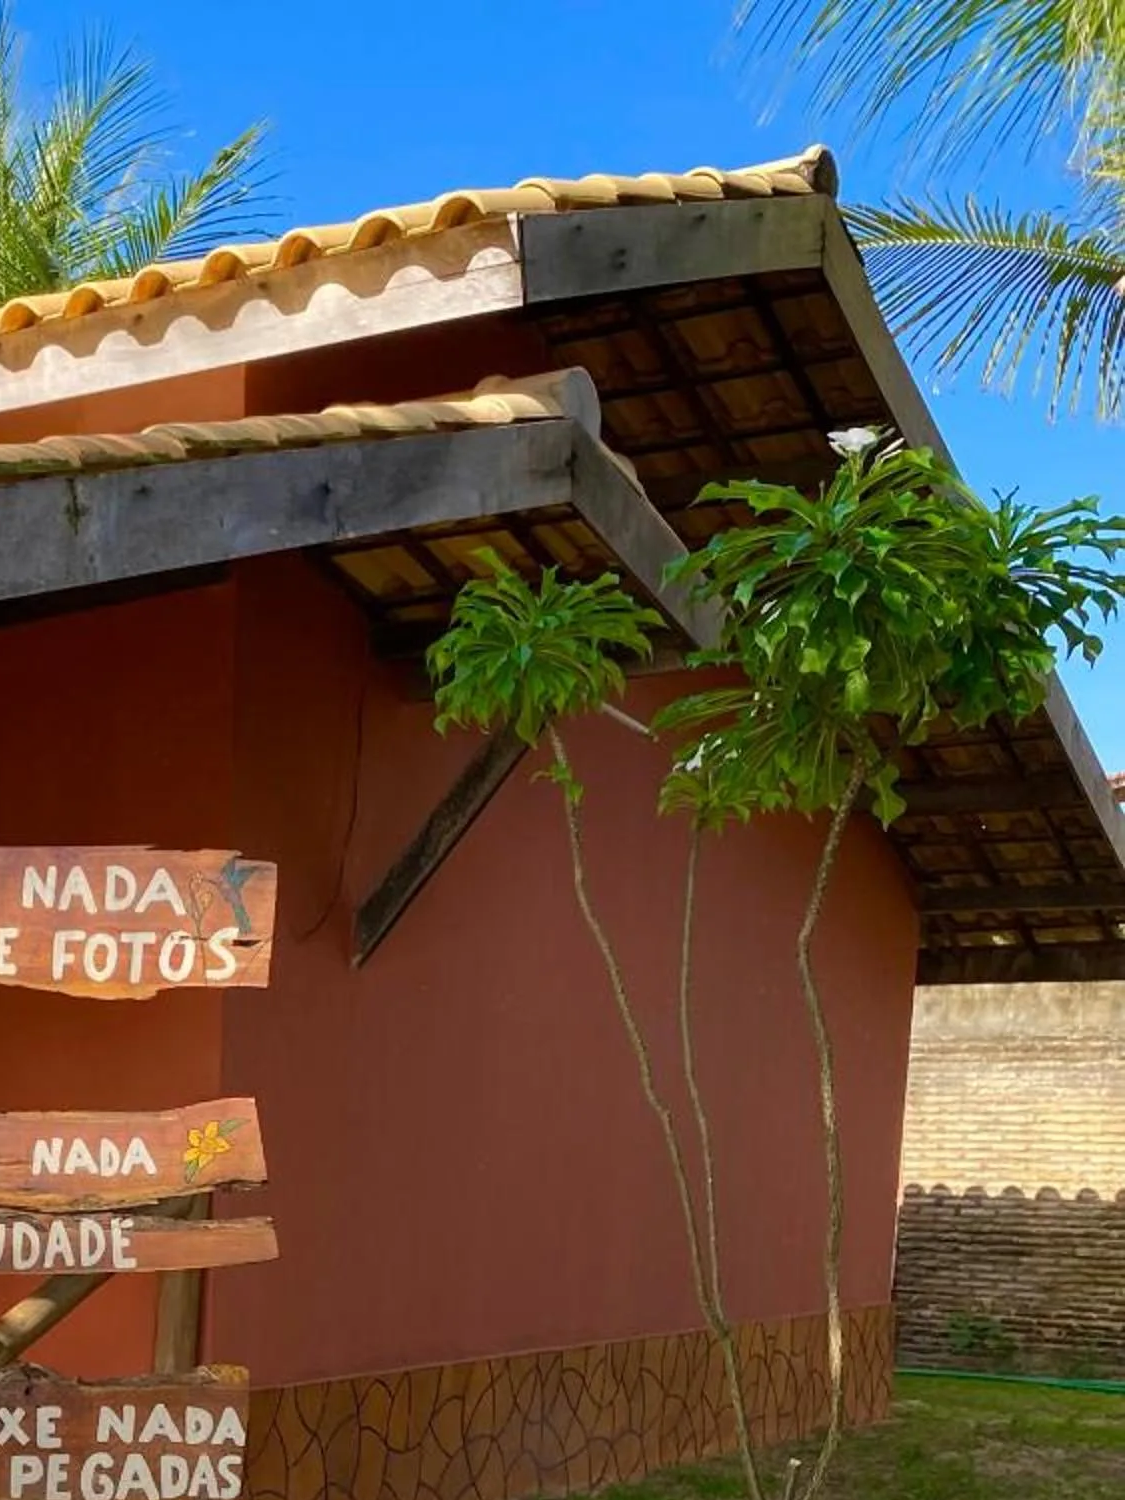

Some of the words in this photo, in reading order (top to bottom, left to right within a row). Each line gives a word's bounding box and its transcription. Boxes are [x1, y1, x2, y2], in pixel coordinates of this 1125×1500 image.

[22, 865, 187, 916] NADA
[52, 927, 240, 985] FOTOS
[32, 1136, 158, 1177] NADA
[96, 1403, 246, 1447] NADA
